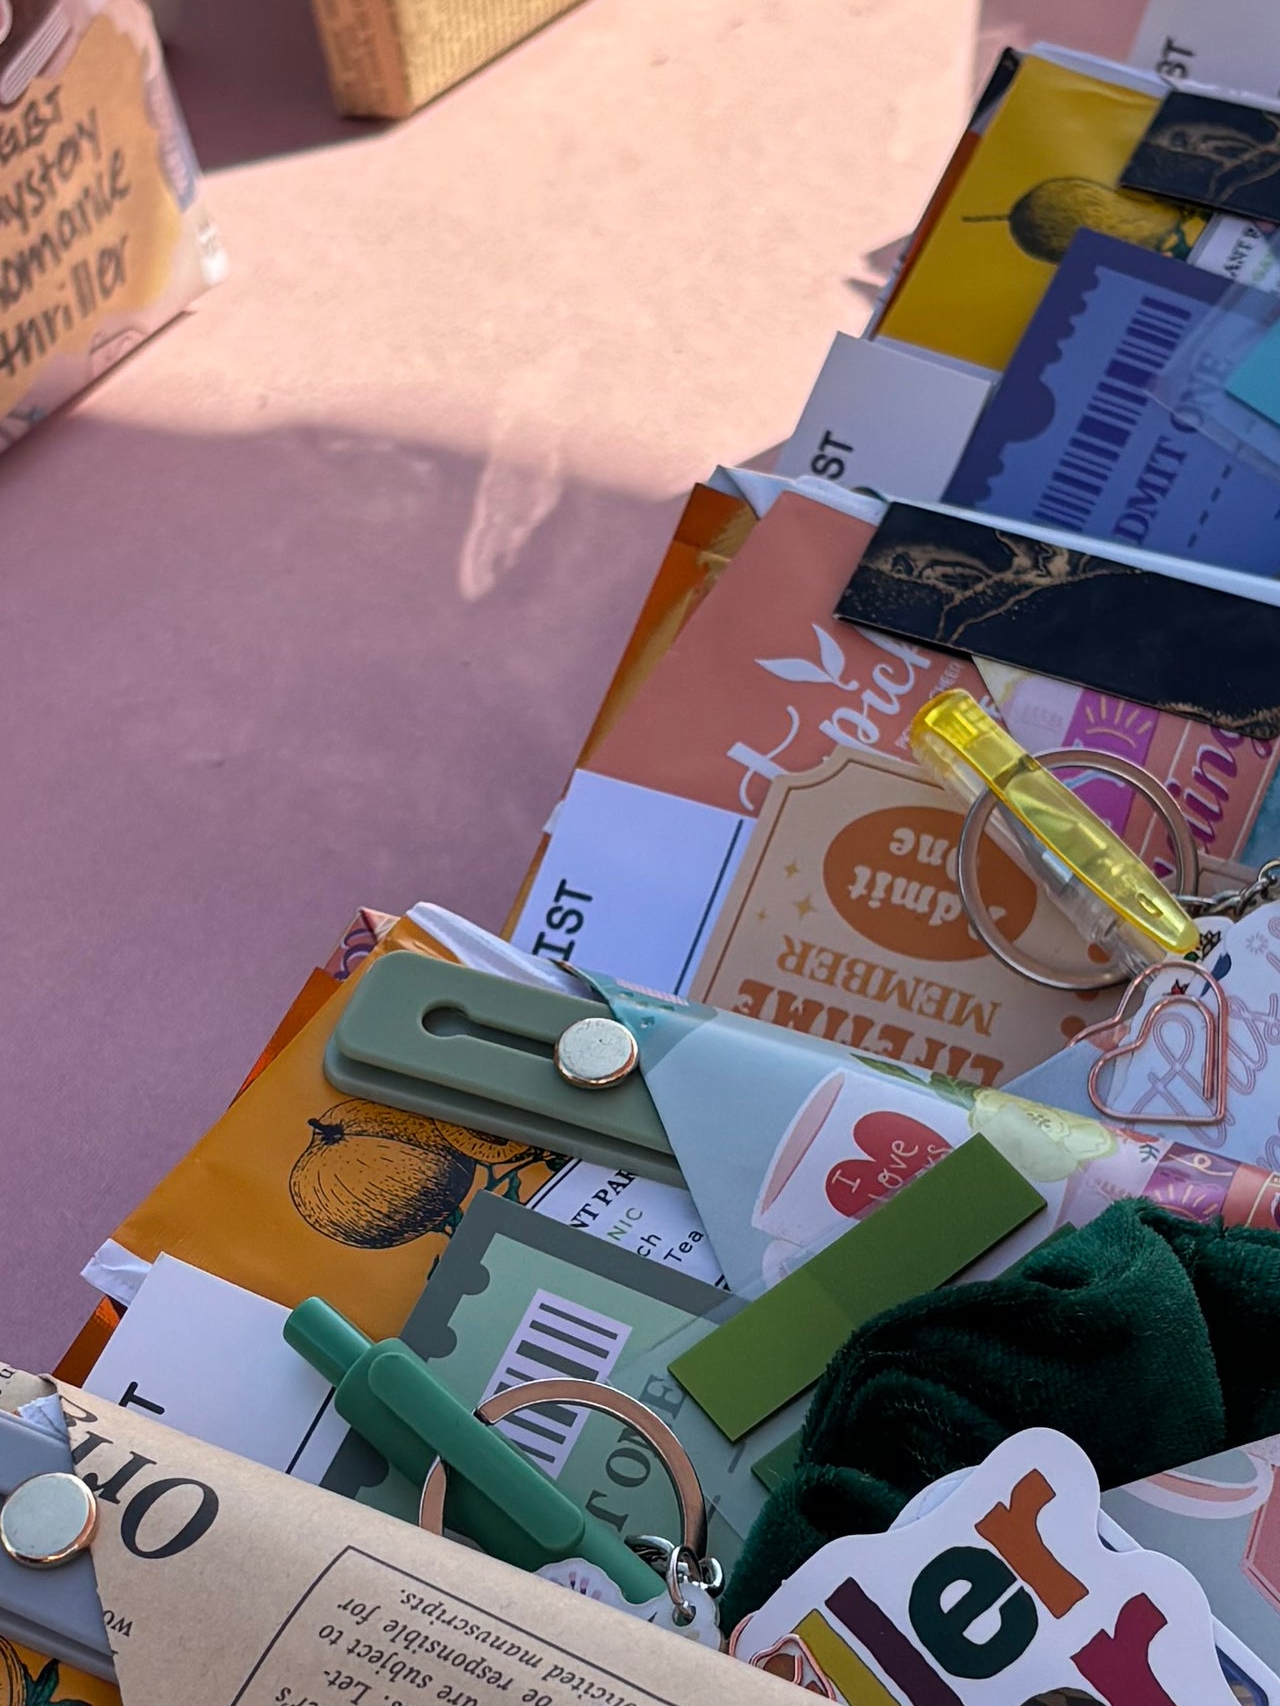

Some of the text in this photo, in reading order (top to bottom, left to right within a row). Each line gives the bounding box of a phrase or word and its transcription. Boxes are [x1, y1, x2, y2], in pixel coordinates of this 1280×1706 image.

[1110, 432, 1192, 544] DMIT
[531, 879, 596, 961] IST
[775, 933, 1003, 1038] MEMBER
[737, 978, 1006, 1089] LIFETIME
[869, 1139, 921, 1206] love
[662, 1226, 705, 1267] Tea
[318, 1624, 344, 1646] to
[337, 1596, 381, 1626] for
[399, 1587, 545, 1670] manuscripts.
[323, 1667, 374, 1706] Let-
[347, 1644, 434, 1690] subject
[382, 1618, 515, 1692] responsible
